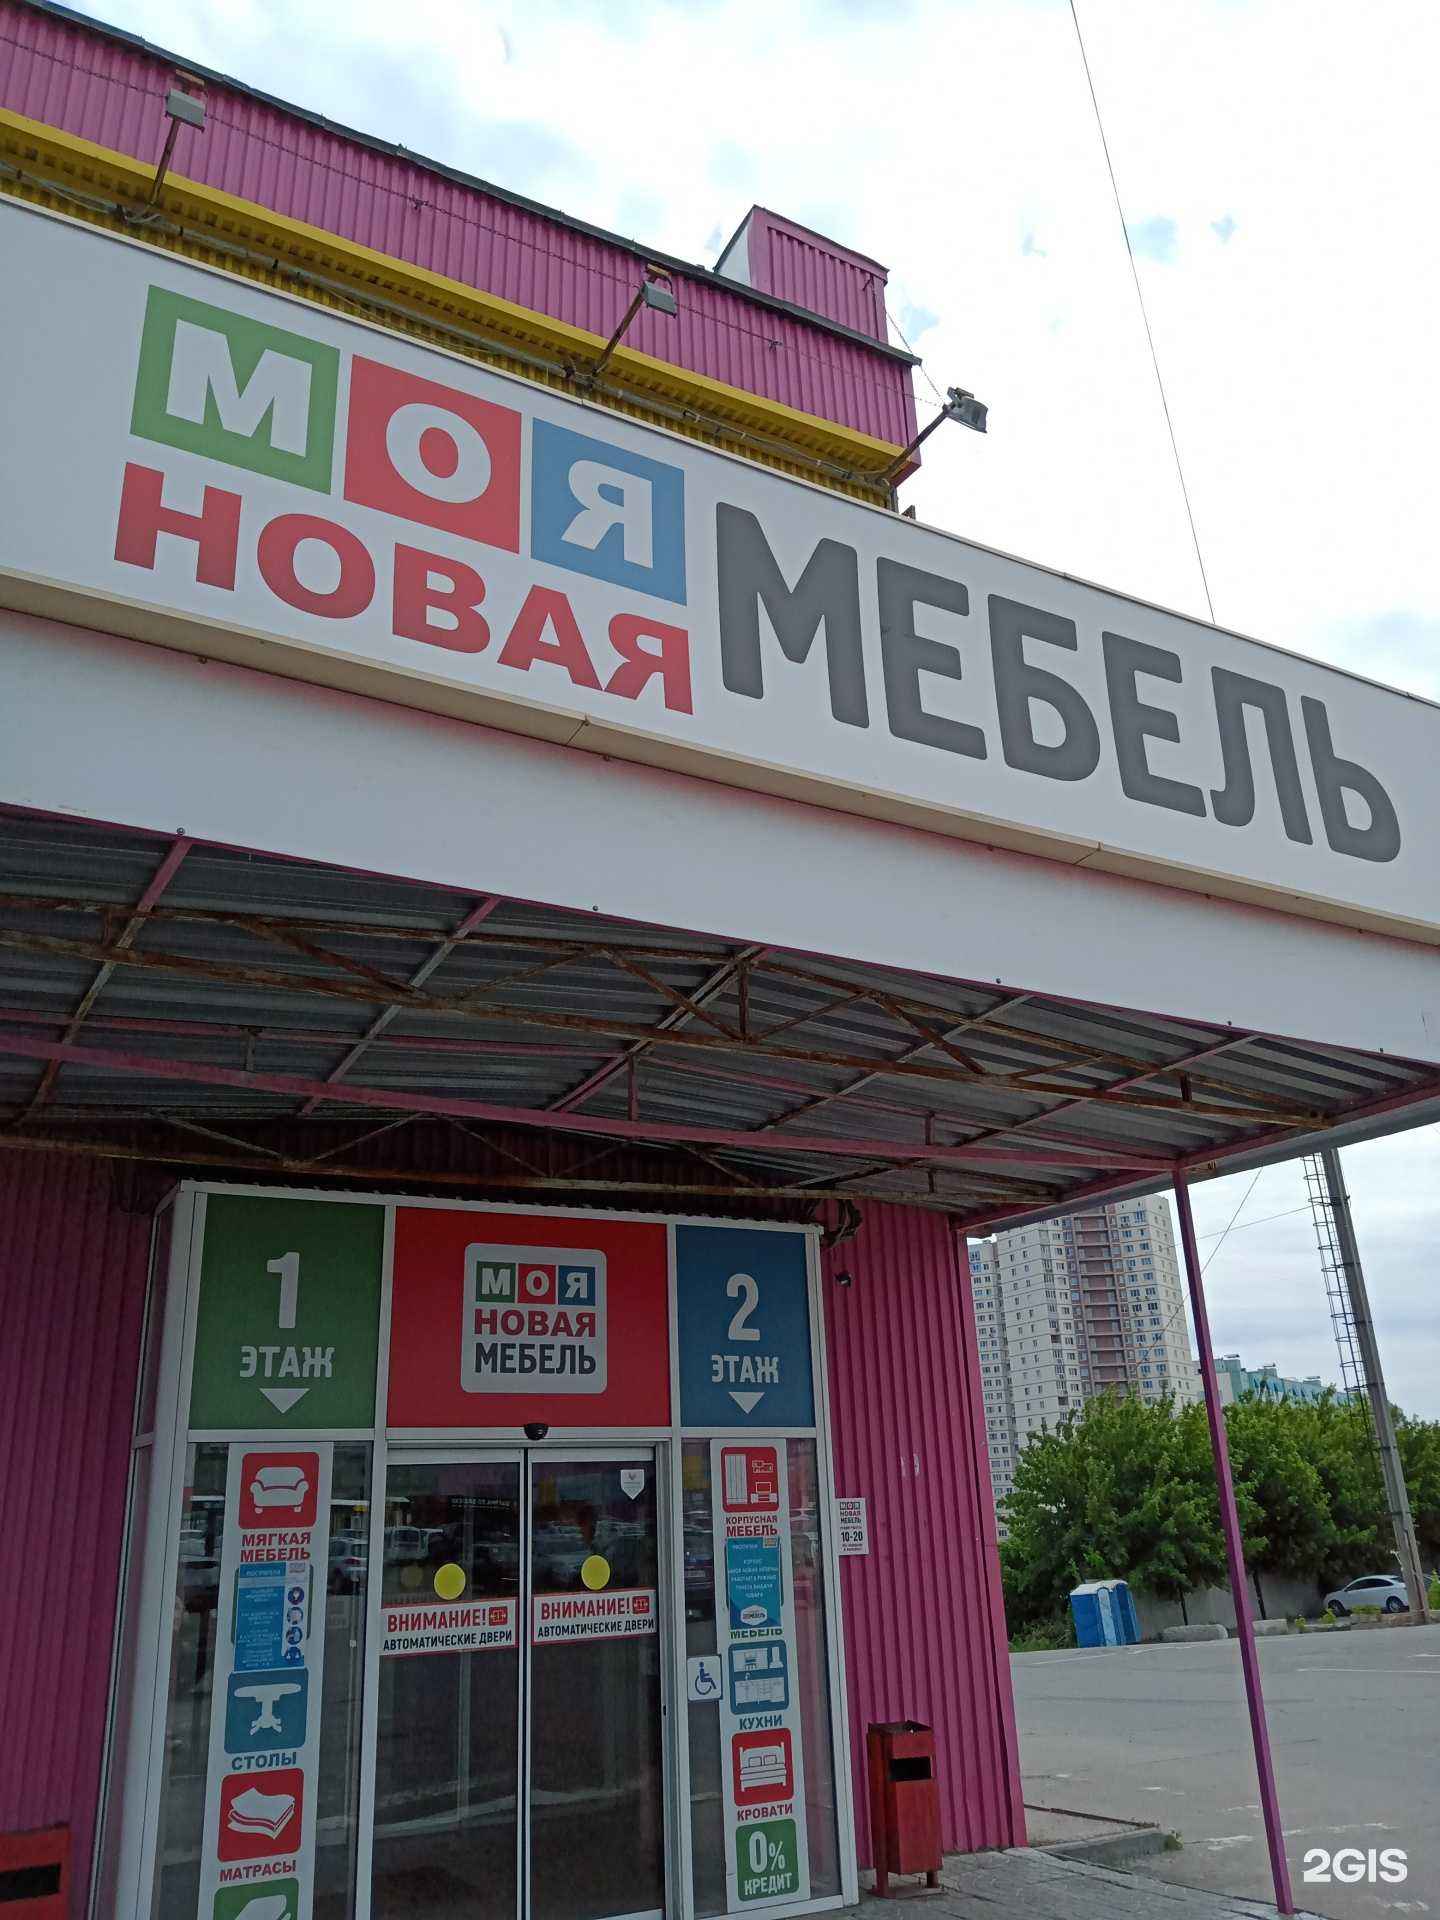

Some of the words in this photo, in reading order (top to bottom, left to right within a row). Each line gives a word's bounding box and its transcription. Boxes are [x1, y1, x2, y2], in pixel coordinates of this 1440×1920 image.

[165, 318, 653, 569] МОЯ
[113, 461, 694, 715] НОВАЯ
[715, 501, 1402, 863] МЕБЕЛЬ
[266, 1251, 301, 1330] 1
[480, 1267, 589, 1300] МОЯ
[726, 1273, 761, 1342] 2
[474, 1308, 597, 1338] НОВАЯ
[239, 1345, 336, 1378] ЭТАЖ
[474, 1342, 597, 1375] МЕБЕЛЬ
[711, 1354, 780, 1384] ЭТАЖ
[725, 1515, 778, 1525] КОРПУСНАЯ
[726, 1525, 778, 1537] МЕБЕЛЬ
[241, 1531, 312, 1548] МЯГКАЯ
[841, 1530, 864, 1542] 10-20
[240, 1547, 311, 1563] МЕБЕЛЬ
[387, 1607, 487, 1633] ВНИМАНИЕ!
[541, 1597, 631, 1620] ВНИМАНИЕ!
[383, 1634, 477, 1651] АВТОМАТИЧЕСКИЕ
[478, 1629, 513, 1645] ДВЕРИ
[537, 1621, 623, 1639] АВТОМАТИЧЕСКИЕ
[623, 1618, 655, 1634] ДВЕРИ
[739, 1714, 783, 1731] КУХНИ
[231, 1752, 297, 1771] СТОЛЫ
[737, 1803, 793, 1822] КРОВАТИ
[748, 1831, 786, 1874] 0%
[219, 1859, 297, 1883] МАТРАСЫ
[743, 1872, 793, 1896] КРЕДИТ
